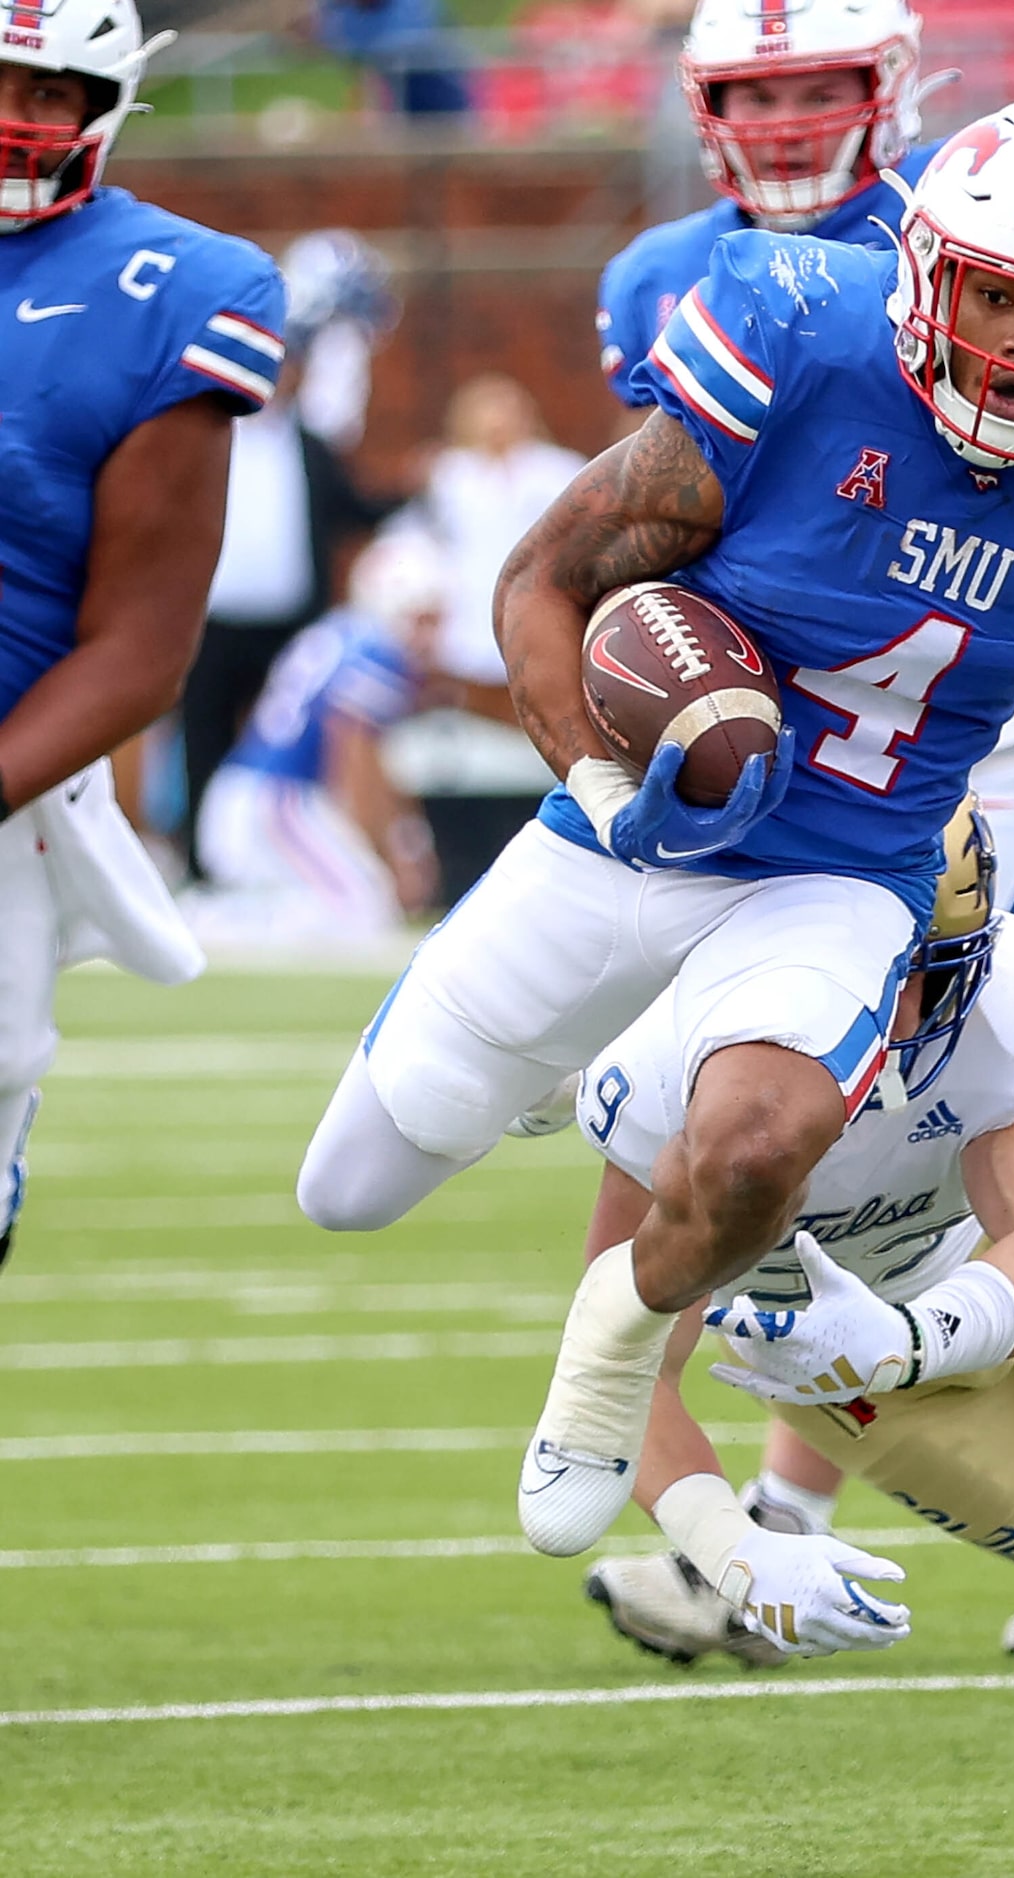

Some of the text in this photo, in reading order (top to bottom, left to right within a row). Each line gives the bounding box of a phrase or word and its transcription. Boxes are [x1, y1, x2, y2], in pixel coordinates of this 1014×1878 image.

[117, 248, 177, 301] C
[836, 447, 892, 510] A
[786, 609, 974, 797] 4
[580, 1063, 632, 1146] 9
[773, 1187, 938, 1251] Tulsa
